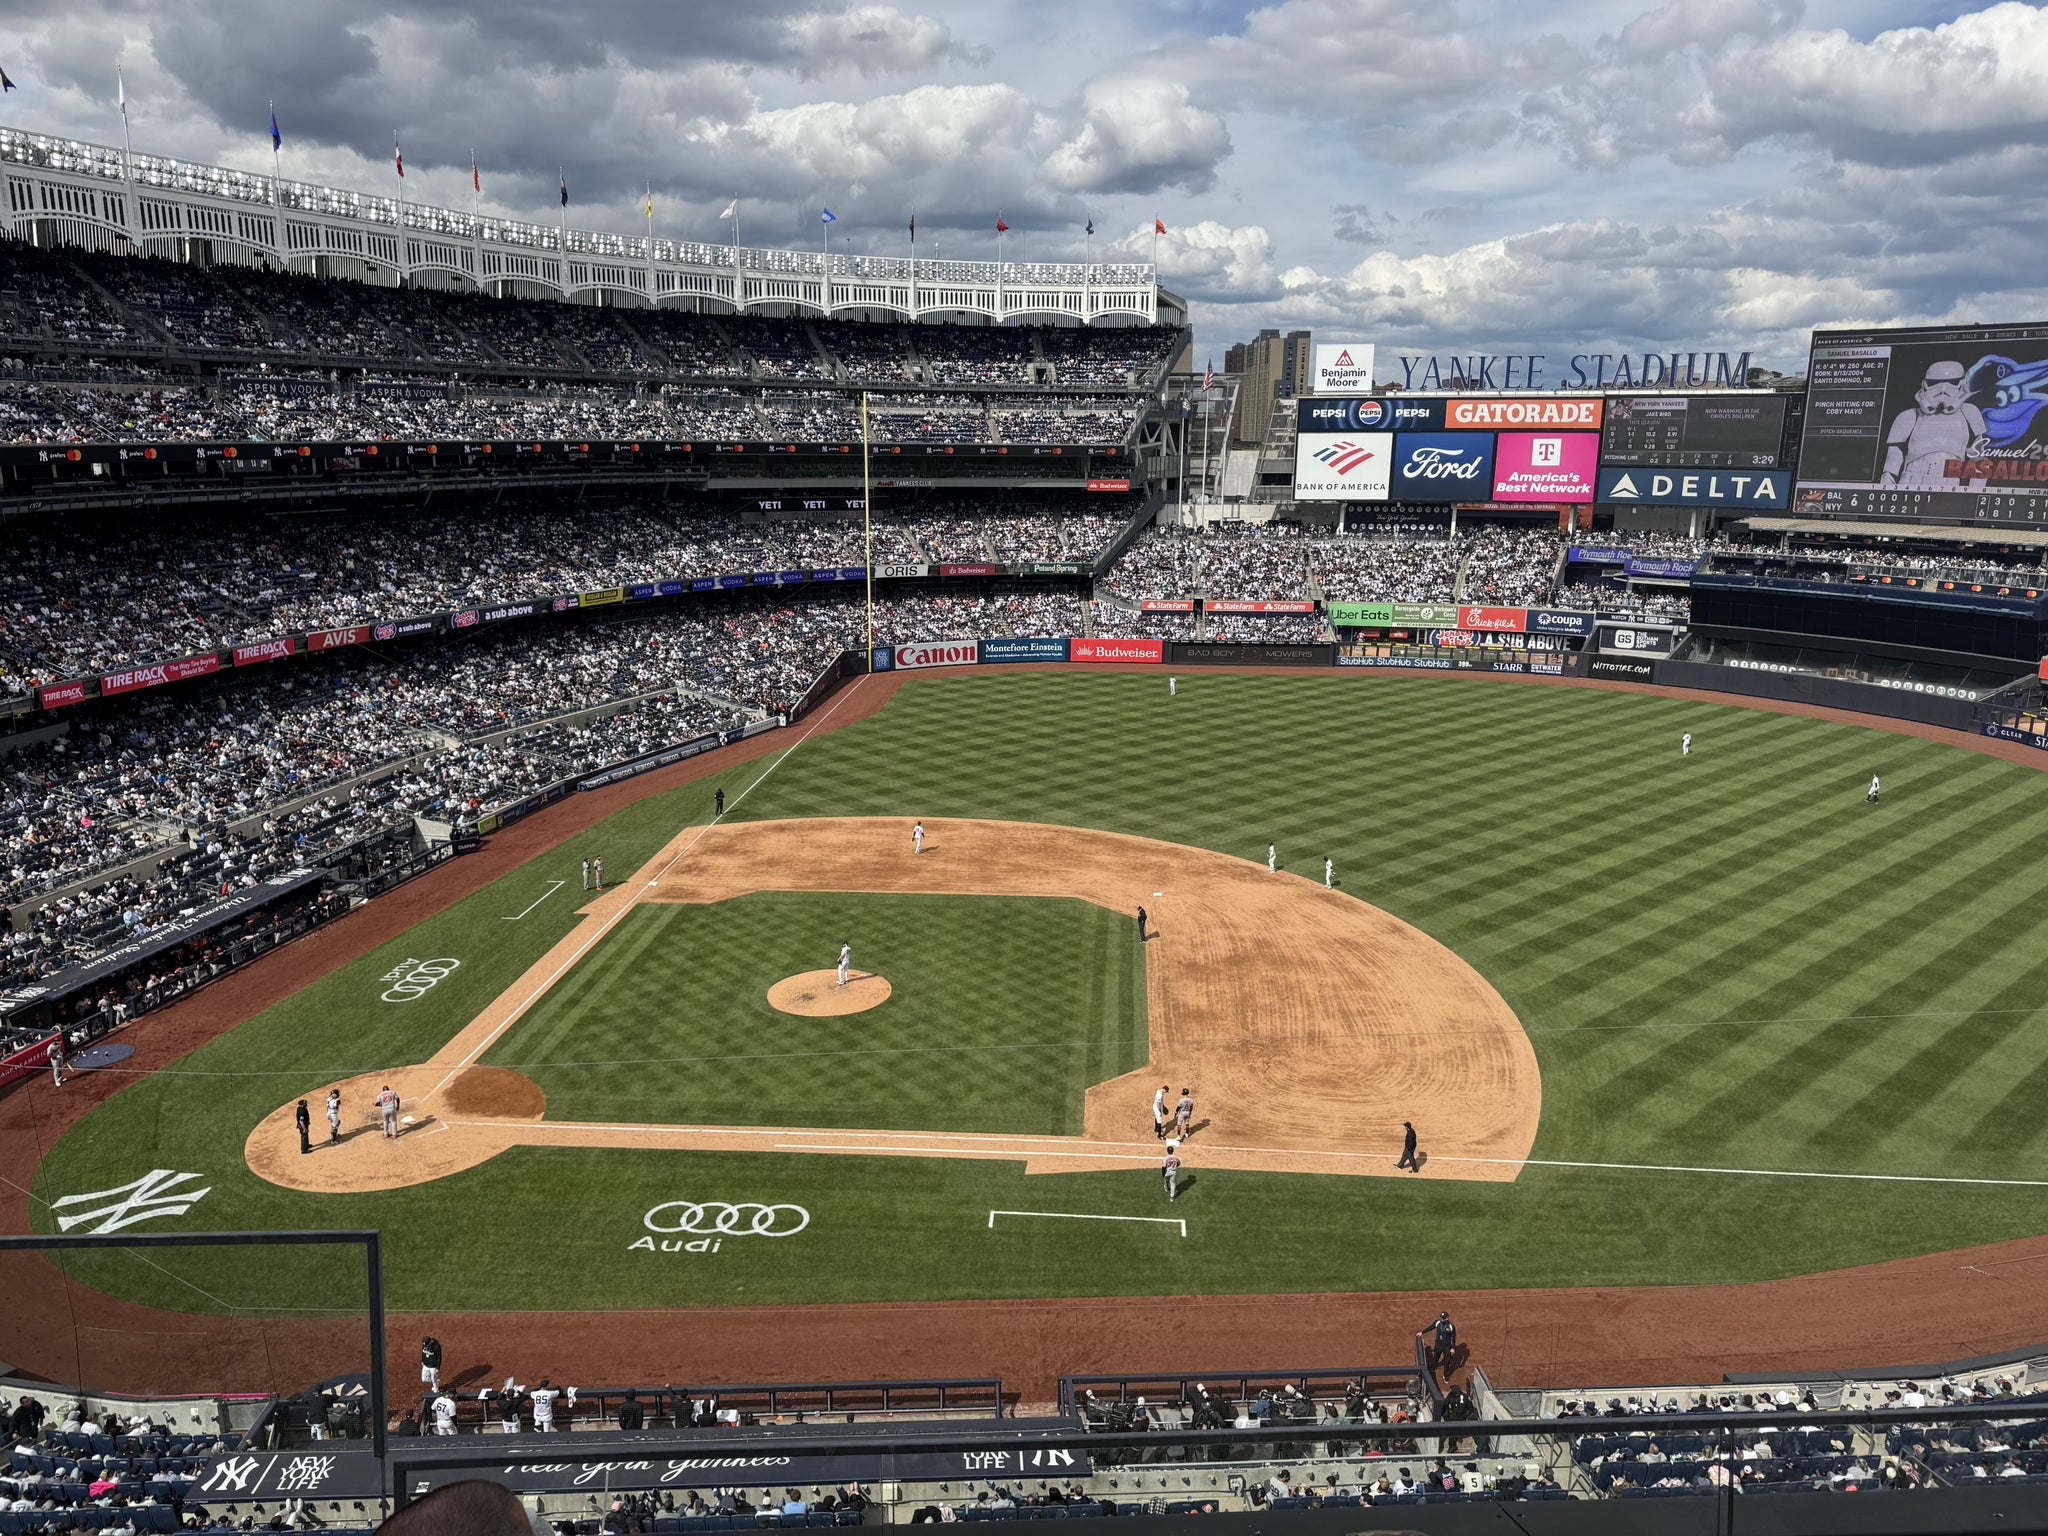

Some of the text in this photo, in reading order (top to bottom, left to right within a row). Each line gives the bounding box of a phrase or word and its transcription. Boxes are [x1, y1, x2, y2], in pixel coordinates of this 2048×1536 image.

[1321, 368, 1366, 378] Benjamin
[1398, 351, 1753, 390] YANKEE STADIUM
[238, 382, 327, 394] ASPEN VODKA
[1326, 378, 1358, 387] Moore
[371, 388, 444, 398] ASPEN VODKA
[1313, 408, 1346, 418] PEPSI
[1395, 408, 1430, 418] PEPSI
[1455, 402, 1594, 423] GATORADE
[1538, 443, 1555, 461] T
[1966, 438, 2038, 458] Samuel
[1403, 447, 1483, 479] Ford
[1752, 455, 1774, 465] 3:29
[1943, 459, 2048, 481] BASALLO
[1508, 472, 1580, 483] America's
[1297, 483, 1386, 491] BANK OF AMERICA
[1496, 482, 1591, 494] Best Network
[1652, 475, 1777, 500] DELTA
[758, 501, 782, 510] YETI
[803, 500, 826, 508] YETI
[846, 500, 866, 508] YET
[1827, 492, 1843, 500] BAL
[1851, 498, 1858, 506] 6
[1904, 494, 1908, 502] 1
[1994, 498, 2000, 506] 3
[2008, 498, 2015, 506] 0
[2030, 499, 2036, 507] 3
[1825, 503, 1843, 511] NYY
[1902, 506, 1908, 514] 2
[1914, 506, 1918, 514] 1
[1992, 510, 1999, 518] 8
[2008, 510, 2012, 518] 1
[2028, 511, 2034, 520] 3
[2042, 512, 2046, 520] 1
[1578, 549, 1615, 559] Plymouth
[884, 565, 918, 577] ORIS
[1034, 565, 1078, 574] Poland Spring
[1630, 561, 1694, 572] Plymouth Rock
[754, 573, 802, 584] ASPEN VODKA
[814, 570, 866, 580] ASPEN VODKA
[693, 578, 743, 590] ASPEN VODKA
[634, 584, 682, 597] ASPEN VODKA
[492, 605, 533, 619] sub above
[1332, 609, 1359, 620] Uber
[1361, 609, 1390, 620] Eats
[402, 621, 432, 632] sub above
[1551, 615, 1583, 627] coupa
[322, 629, 356, 648] AVIS
[1485, 633, 1493, 645] A
[1527, 635, 1571, 650] ABOVE
[1618, 634, 1632, 643] GS
[237, 640, 290, 660] TIRE RACK
[270, 650, 284, 658] .com
[985, 643, 1063, 653] Montefiore Einstein
[1266, 650, 1313, 658] MOWERS
[896, 645, 976, 667] Canon
[1340, 657, 1374, 666] StubHub
[170, 656, 216, 672] The Way Buying
[1377, 658, 1411, 667] StubHub
[1414, 659, 1449, 668] StubHub
[1493, 662, 1523, 671] STARR
[1531, 663, 1562, 671] CUTWATER
[1592, 661, 1650, 675] NITTOTIRE.COM
[105, 666, 170, 689] TIRE RACK
[180, 667, 196, 677] Should
[146, 678, 164, 687] .com
[44, 687, 84, 702] TIRE RACK
[2001, 729, 2023, 739] CLEAR
[394, 820, 414, 833] StubHub
[364, 834, 385, 847] StubHub
[331, 848, 352, 861] StubHub
[140, 920, 192, 945] Yankee
[80, 943, 140, 970] Stadium
[380, 958, 420, 981] Audi
[626, 1236, 722, 1254] Audi
[536, 1394, 548, 1405] 85
[436, 1402, 447, 1413] 67
[288, 1456, 337, 1469] NEW
[965, 1458, 1006, 1470] LIFE
[280, 1466, 335, 1480] YORK
[276, 1478, 320, 1491] LIFE
